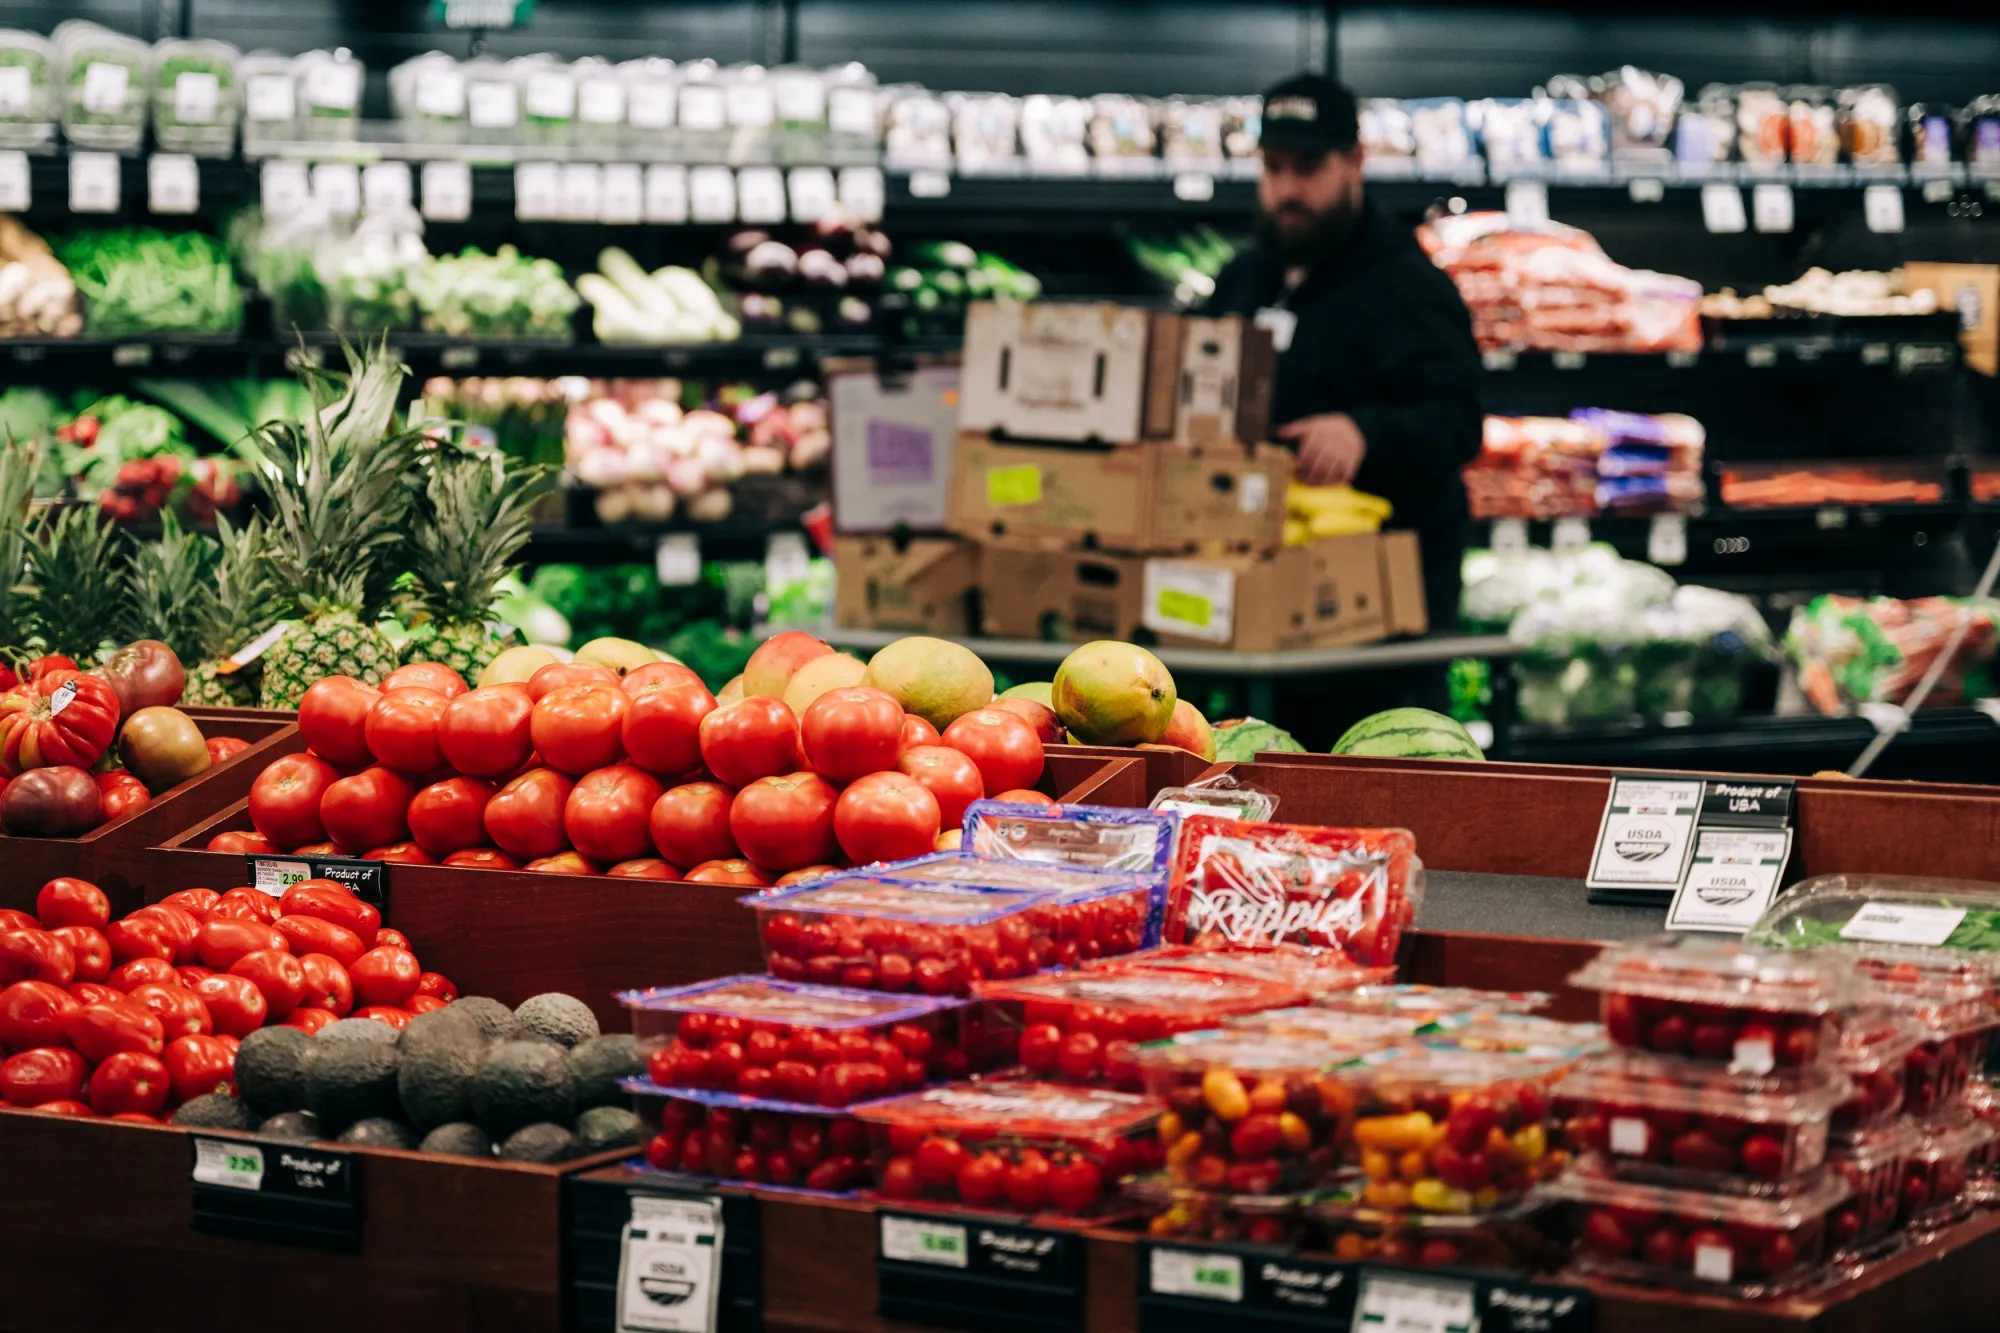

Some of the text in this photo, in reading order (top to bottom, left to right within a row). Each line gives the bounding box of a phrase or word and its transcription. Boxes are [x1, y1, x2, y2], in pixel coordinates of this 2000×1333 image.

[1715, 784, 1782, 799] Product of
[1729, 798, 1760, 812] USA
[1627, 829, 1662, 840] USDA
[325, 867, 373, 880] Product of
[341, 882, 360, 892] SA
[1710, 877, 1746, 887] USDA
